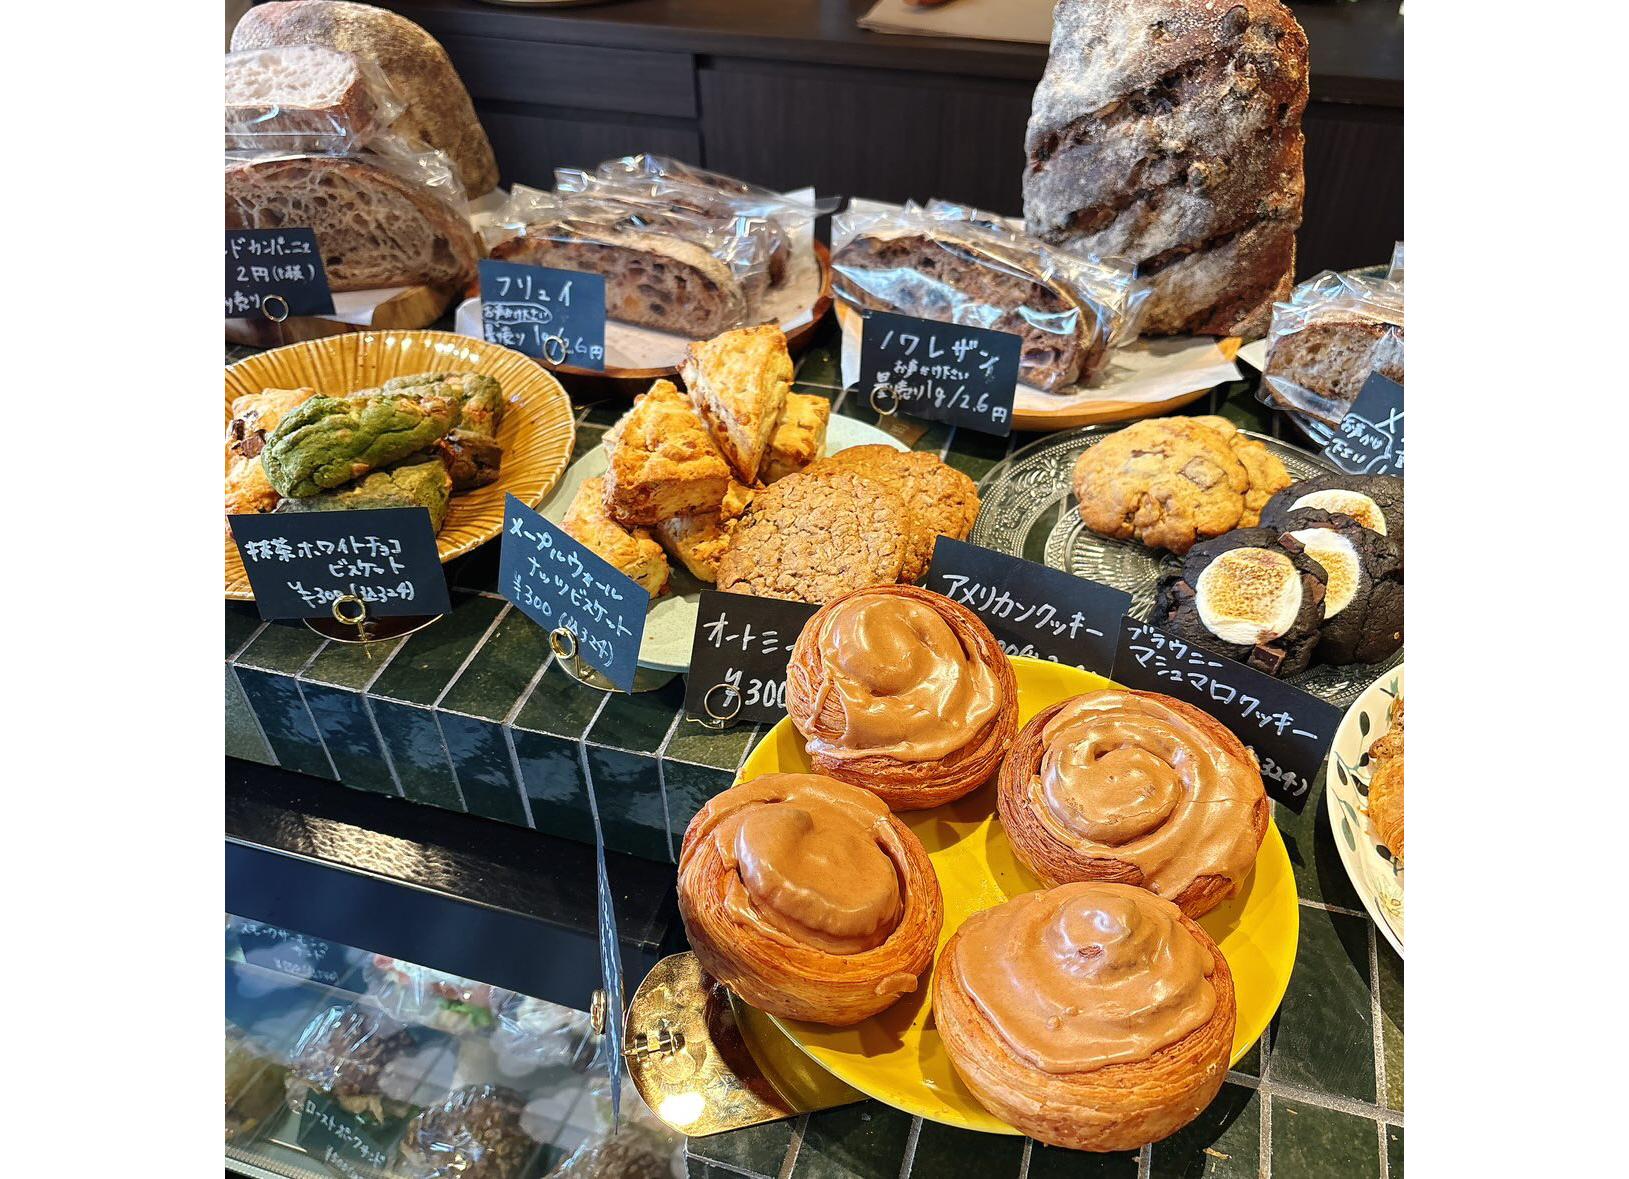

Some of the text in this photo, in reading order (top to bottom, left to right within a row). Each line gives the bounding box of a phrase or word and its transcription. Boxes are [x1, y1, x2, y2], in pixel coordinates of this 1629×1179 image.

[225, 236, 312, 259] ドカンパーニュ
[496, 275, 573, 307] フリュイ
[880, 330, 1000, 370] ノワレザン
[244, 536, 402, 563] 抹茶ホワイトチョコ
[942, 574, 1104, 640] アメリカンクッキー
[1127, 625, 1224, 668] ブラウニー
[1129, 645, 1319, 740] マシュマロクッキー
